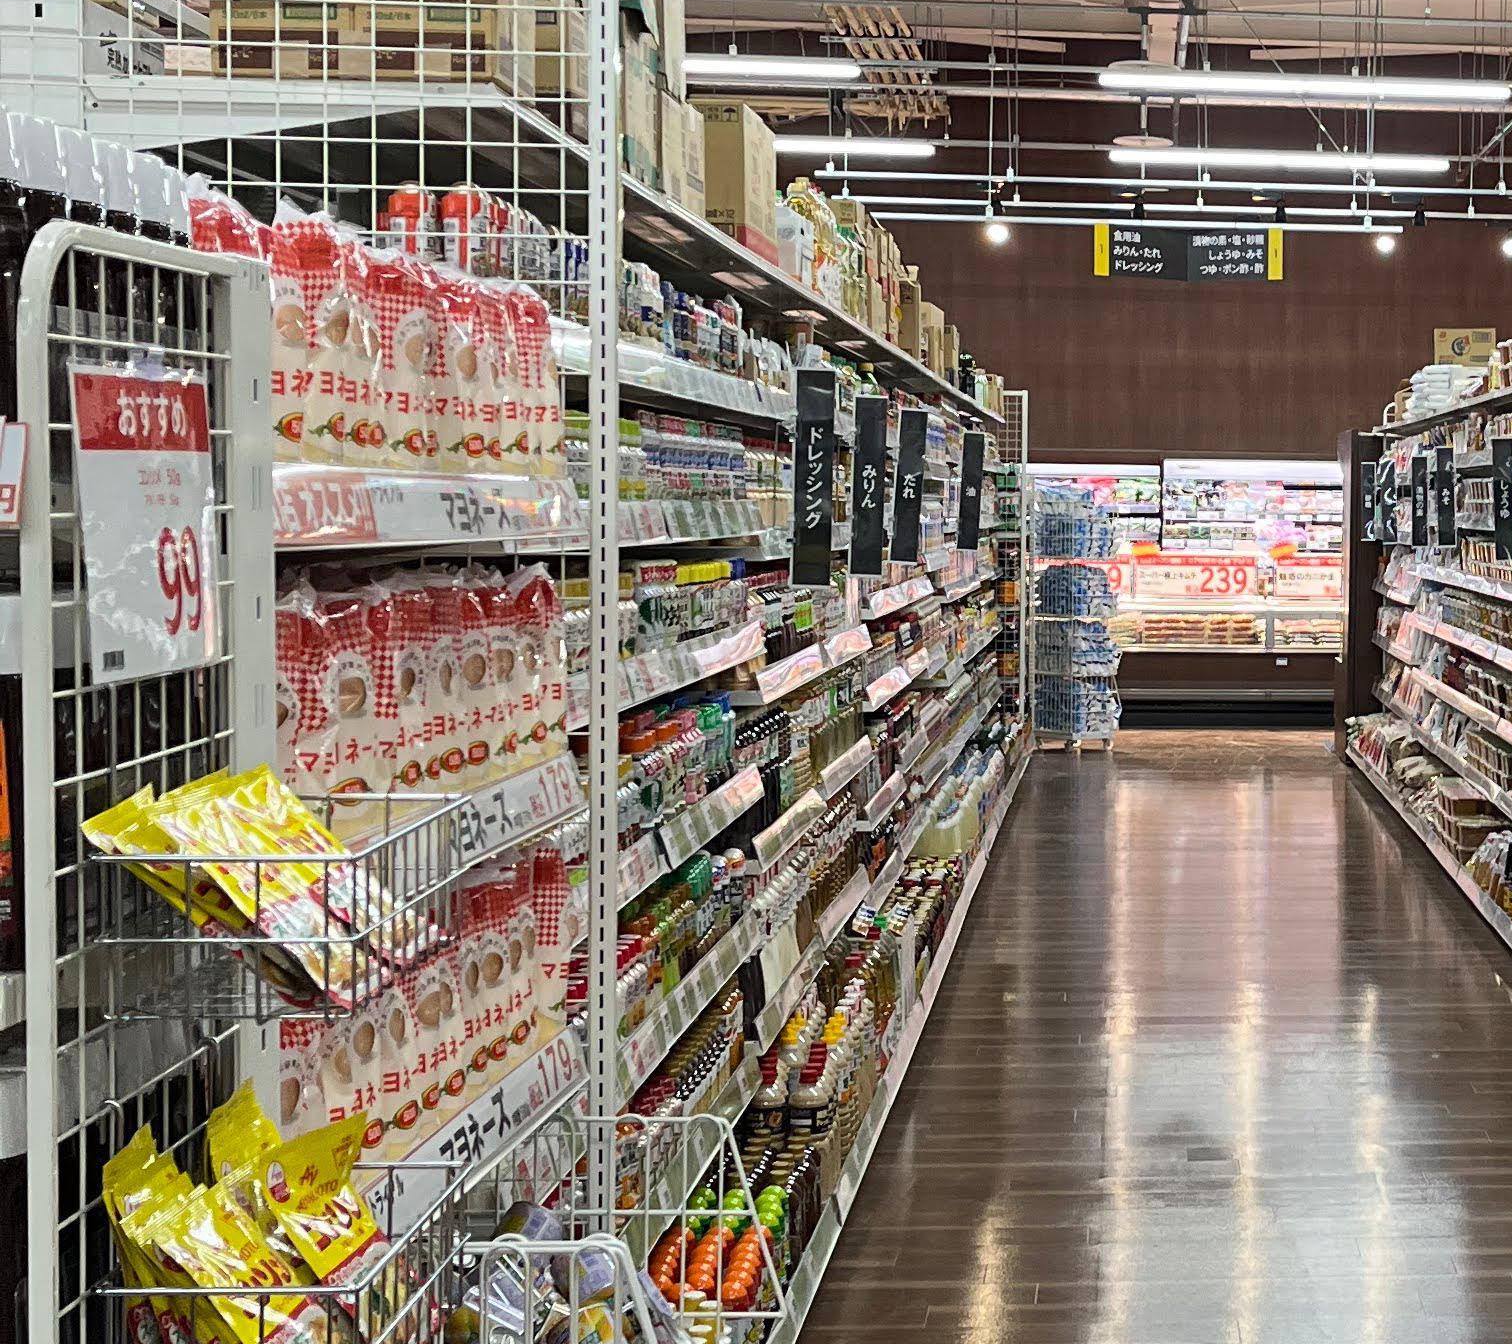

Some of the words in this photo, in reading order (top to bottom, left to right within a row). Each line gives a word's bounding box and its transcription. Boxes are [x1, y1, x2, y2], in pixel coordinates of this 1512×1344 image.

[1114, 230, 1140, 242] 食用油
[1114, 246, 1161, 258] みりん・たれ
[1208, 250, 1263, 261] しょうゆ・みそ
[1115, 260, 1163, 273] ドレッシング
[1200, 263, 1264, 275] つゆ・ポン酢・酢
[117, 389, 186, 438] おすすめ
[806, 427, 823, 528] ドレッシング
[862, 465, 876, 508] みりん
[902, 473, 916, 499] たれ
[966, 487, 976, 496] 油
[1442, 489, 1450, 505] みそ
[1500, 480, 1510, 518] しょうゆ
[158, 526, 201, 635] 99
[1200, 567, 1248, 594] 239
[539, 756, 575, 814] 179
[539, 1039, 574, 1098] 179
